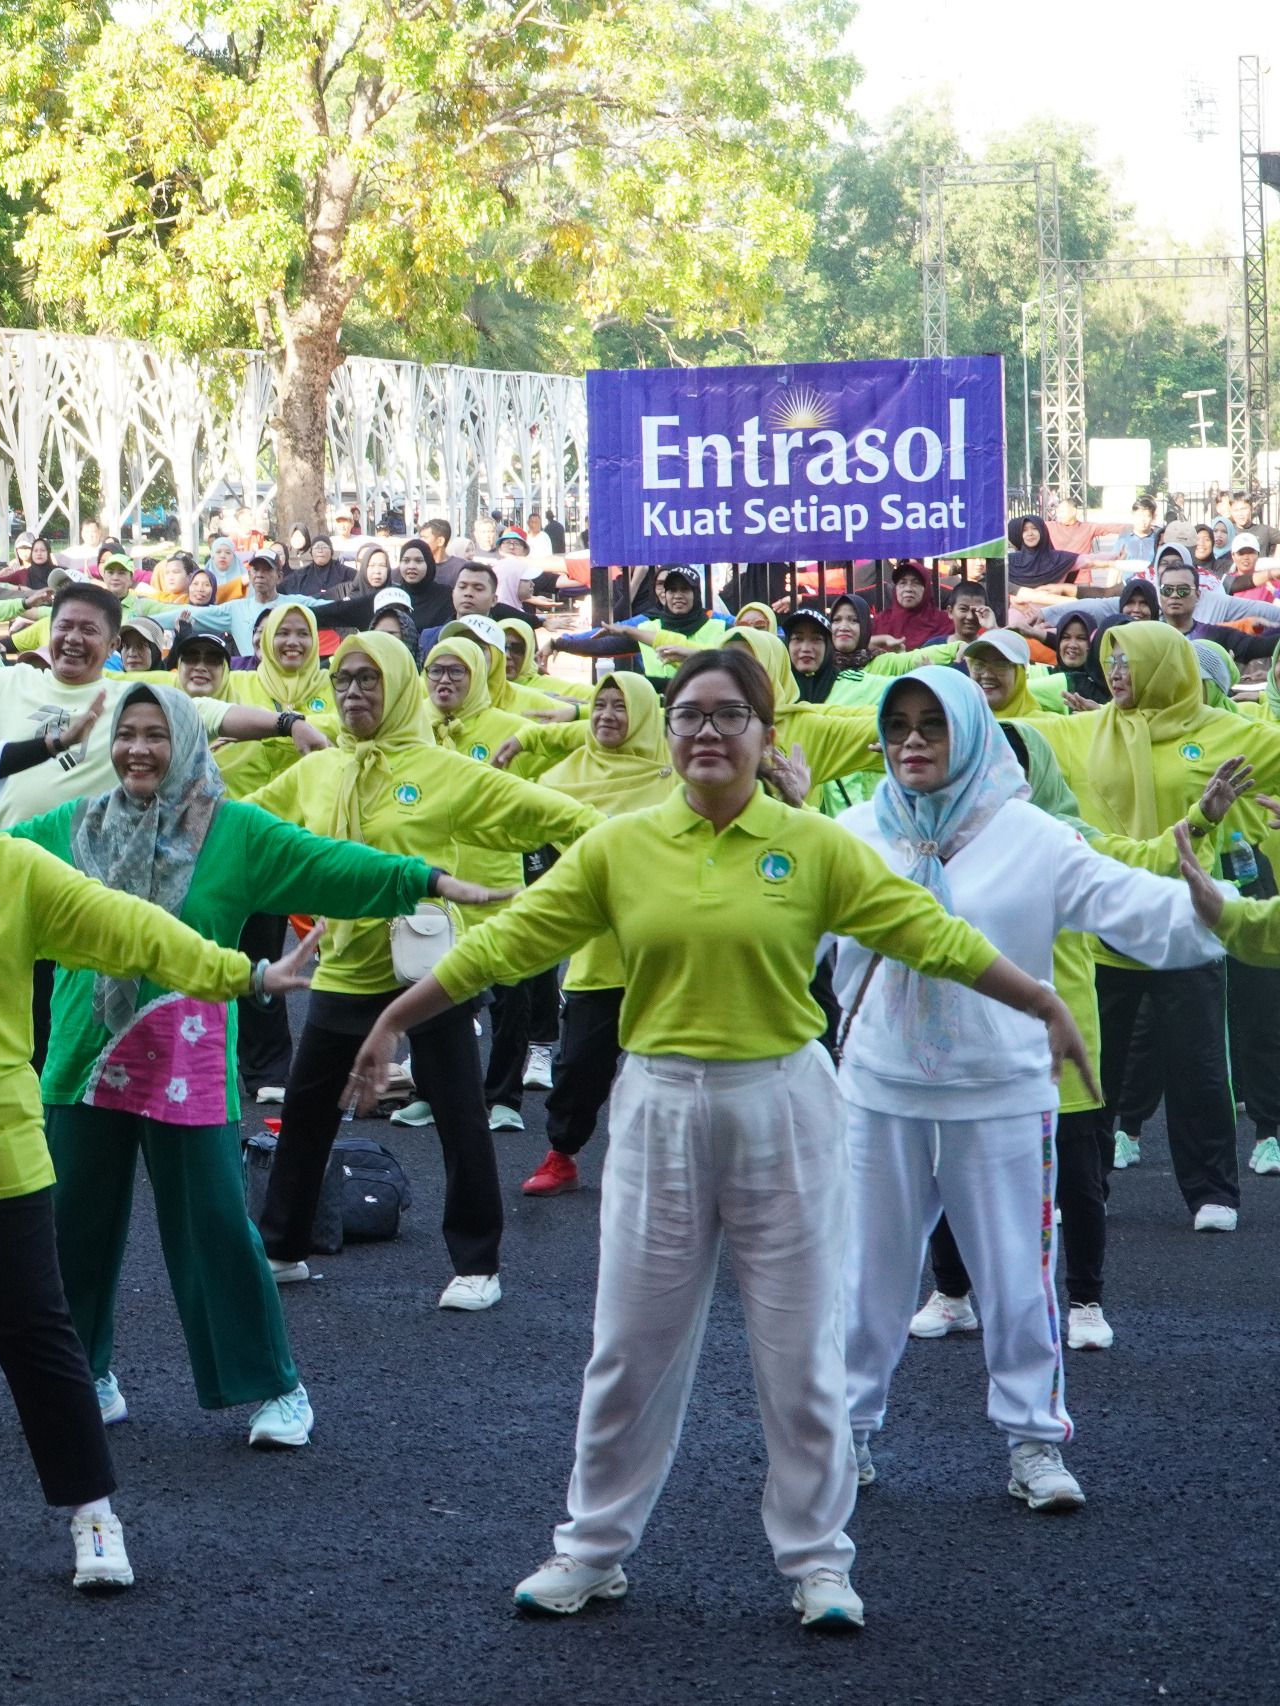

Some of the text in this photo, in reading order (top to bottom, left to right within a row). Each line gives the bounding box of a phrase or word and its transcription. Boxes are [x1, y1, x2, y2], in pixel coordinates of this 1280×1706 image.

[641, 398, 966, 490] Entrasol
[643, 493, 966, 543] Kuat Setiap Saat
